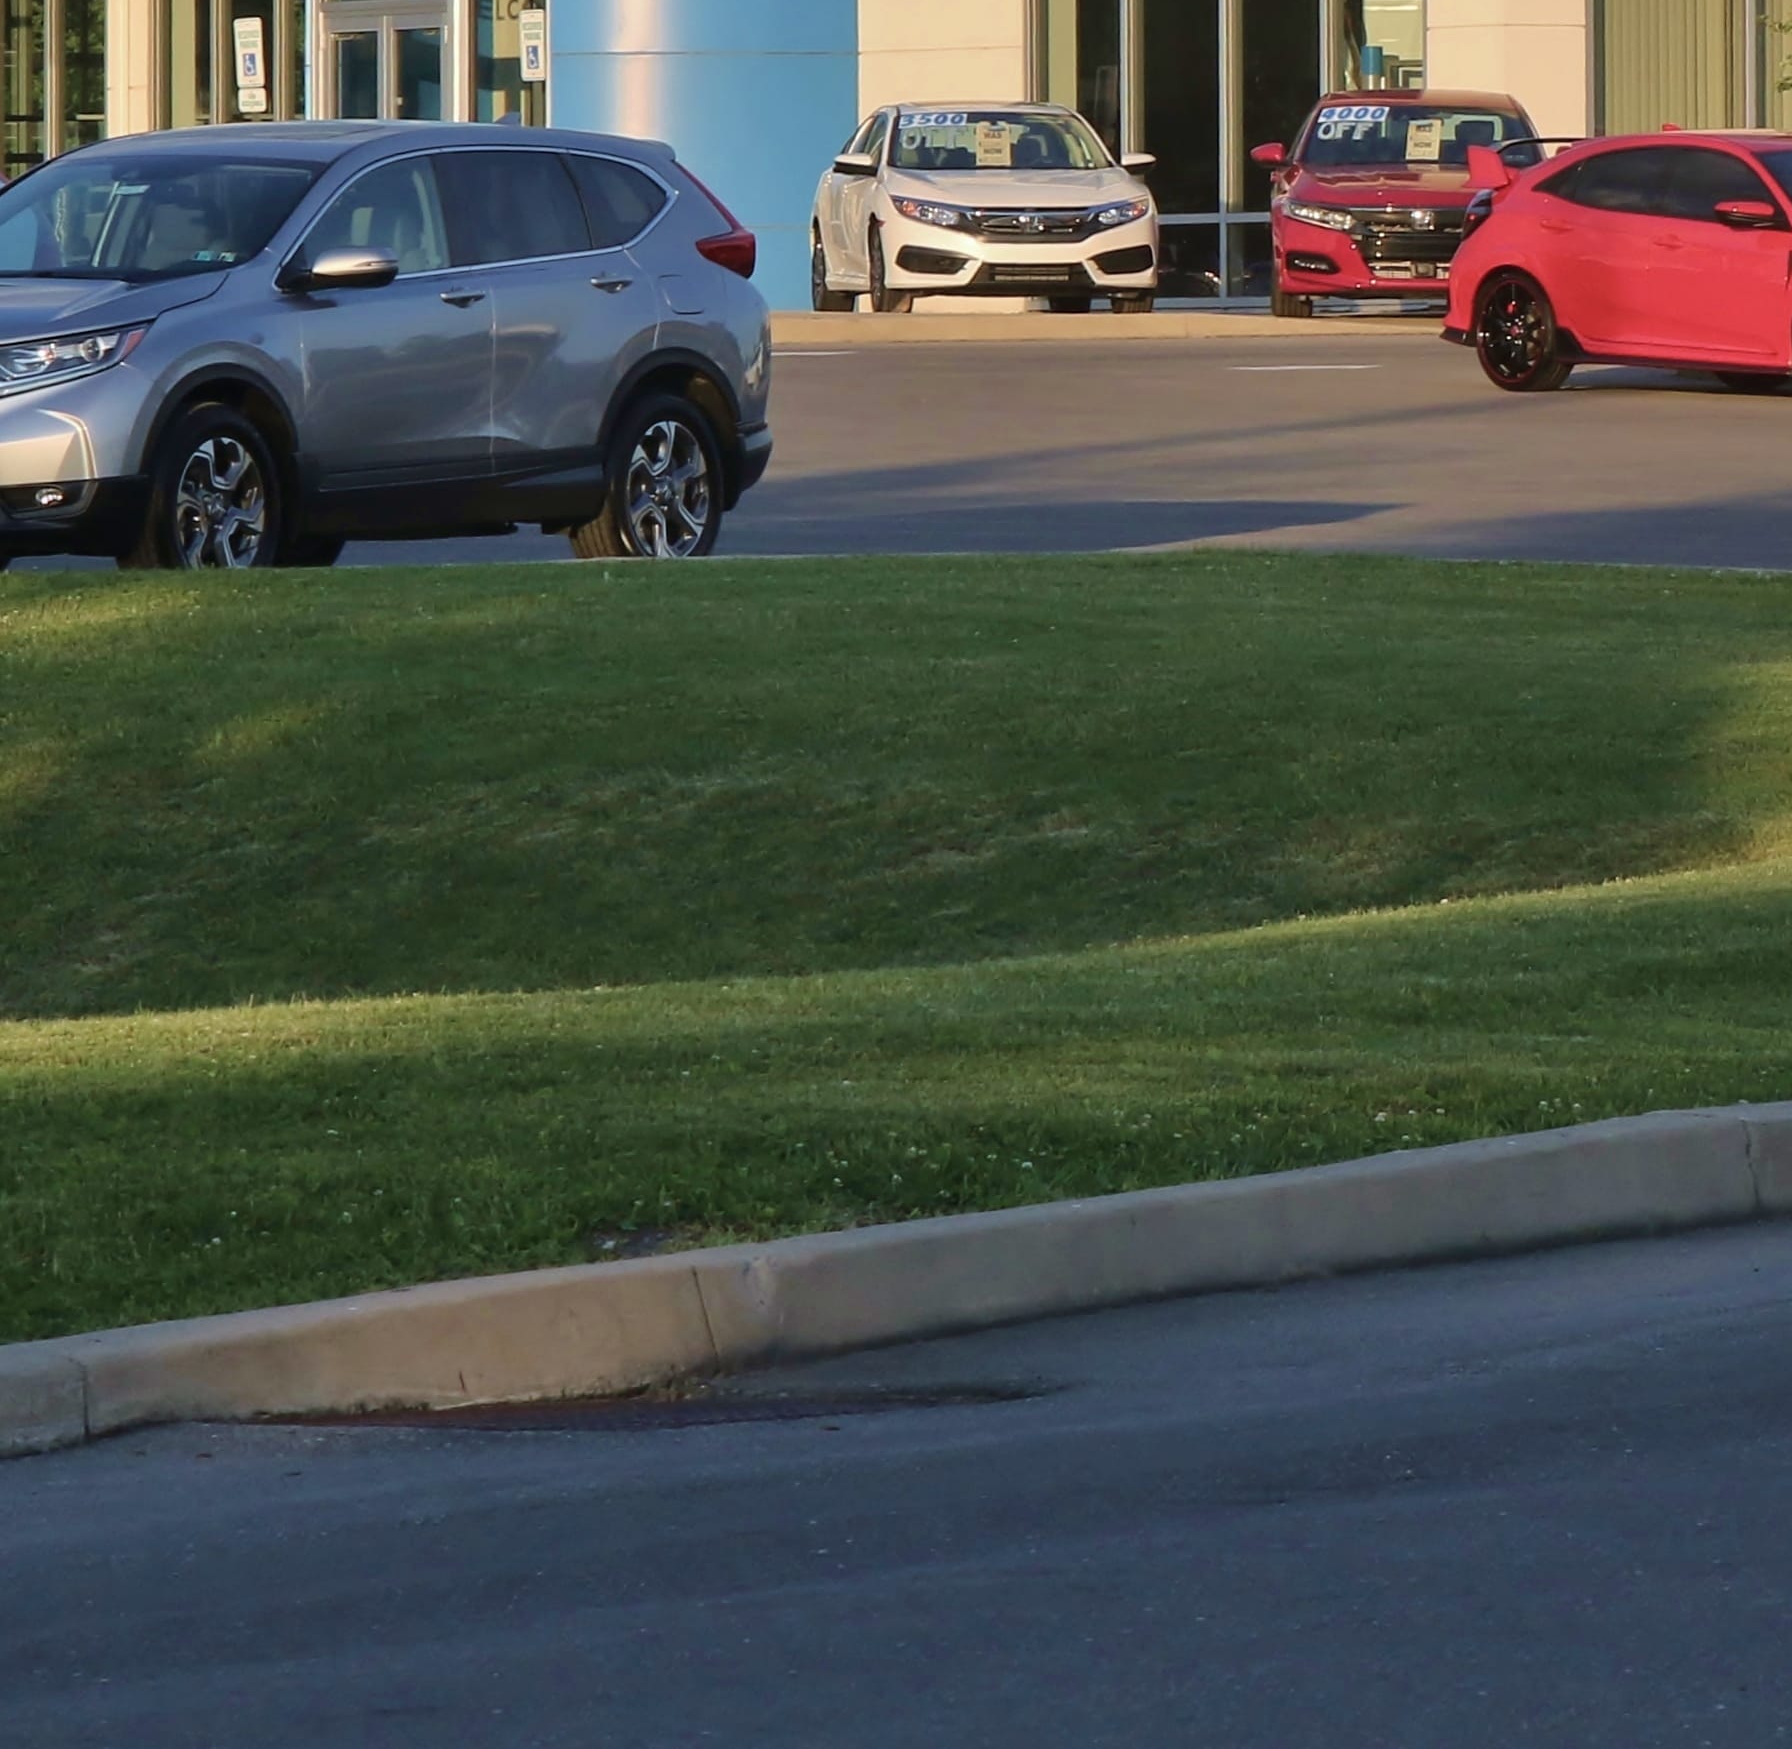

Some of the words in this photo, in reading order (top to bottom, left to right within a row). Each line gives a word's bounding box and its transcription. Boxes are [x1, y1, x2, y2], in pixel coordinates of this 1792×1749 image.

[1322, 107, 1386, 120] 4000
[900, 114, 965, 127] 3500
[1317, 122, 1373, 140] OFF
